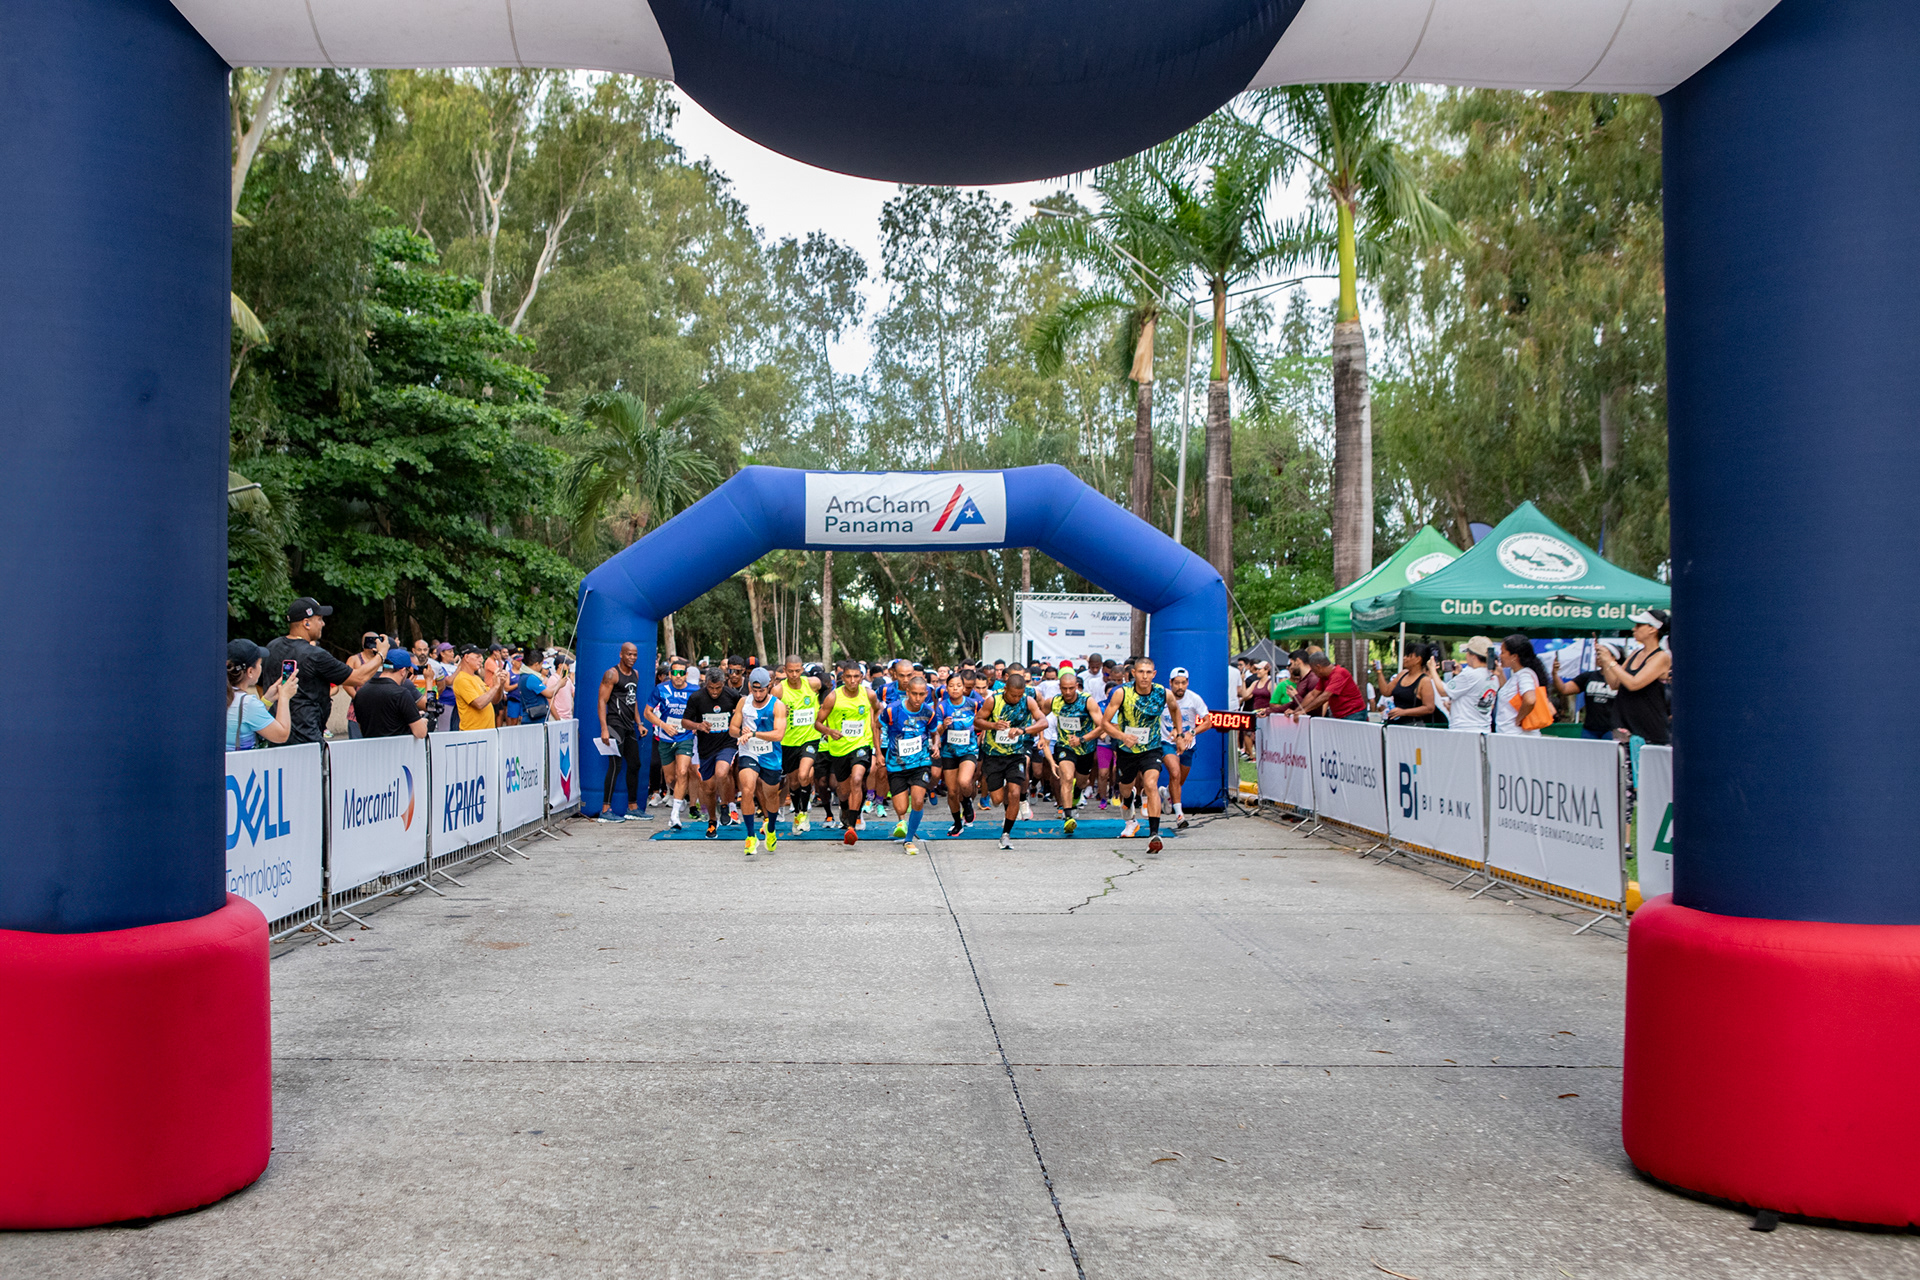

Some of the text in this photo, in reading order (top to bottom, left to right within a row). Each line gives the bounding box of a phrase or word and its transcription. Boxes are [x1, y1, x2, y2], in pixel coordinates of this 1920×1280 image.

[825, 495, 930, 513] AmCham
[825, 516, 914, 533] Panama
[1440, 599, 1484, 615] Club
[1489, 600, 1592, 617] Corredores
[1597, 603, 1626, 619] del
[505, 756, 539, 794] aes Panamá
[1339, 751, 1378, 790] business
[226, 767, 291, 851] DELL
[342, 778, 400, 831] Mercantil
[443, 775, 486, 834] KPMG
[1422, 794, 1471, 820] BI BANK
[1498, 774, 1604, 830] BIODERMA
[1497, 817, 1605, 851] LABORATOIRE DERMATOLOGIQUE
[226, 856, 292, 899] Technologies
